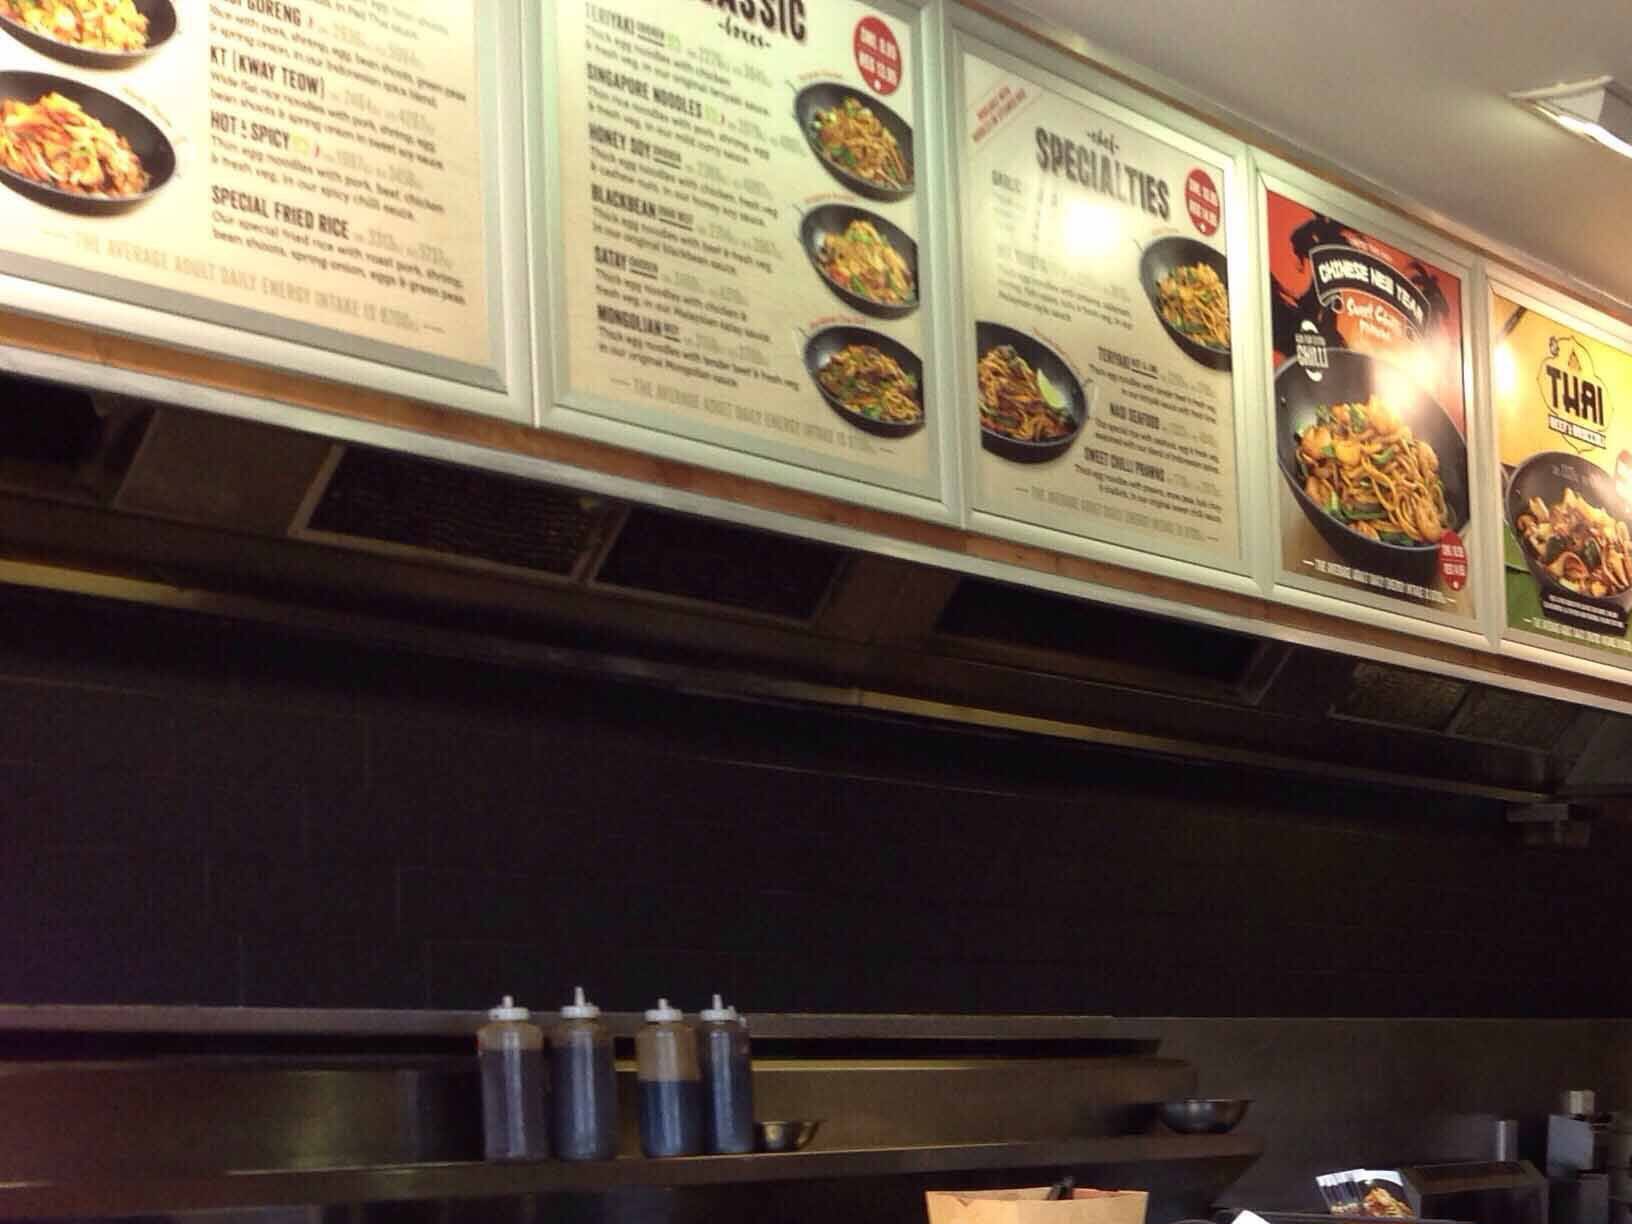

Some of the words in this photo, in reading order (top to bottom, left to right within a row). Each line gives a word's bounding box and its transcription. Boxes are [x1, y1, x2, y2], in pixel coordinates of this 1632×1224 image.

[210, 45, 227, 67] KT
[210, 111, 237, 133] HOT
[250, 122, 291, 150] SPICY
[210, 184, 270, 219] SPECIAL
[274, 200, 315, 230] FRIED
[318, 213, 350, 241] RICE
[1318, 258, 1370, 284] CHINESE
[1545, 364, 1605, 427] THAI
